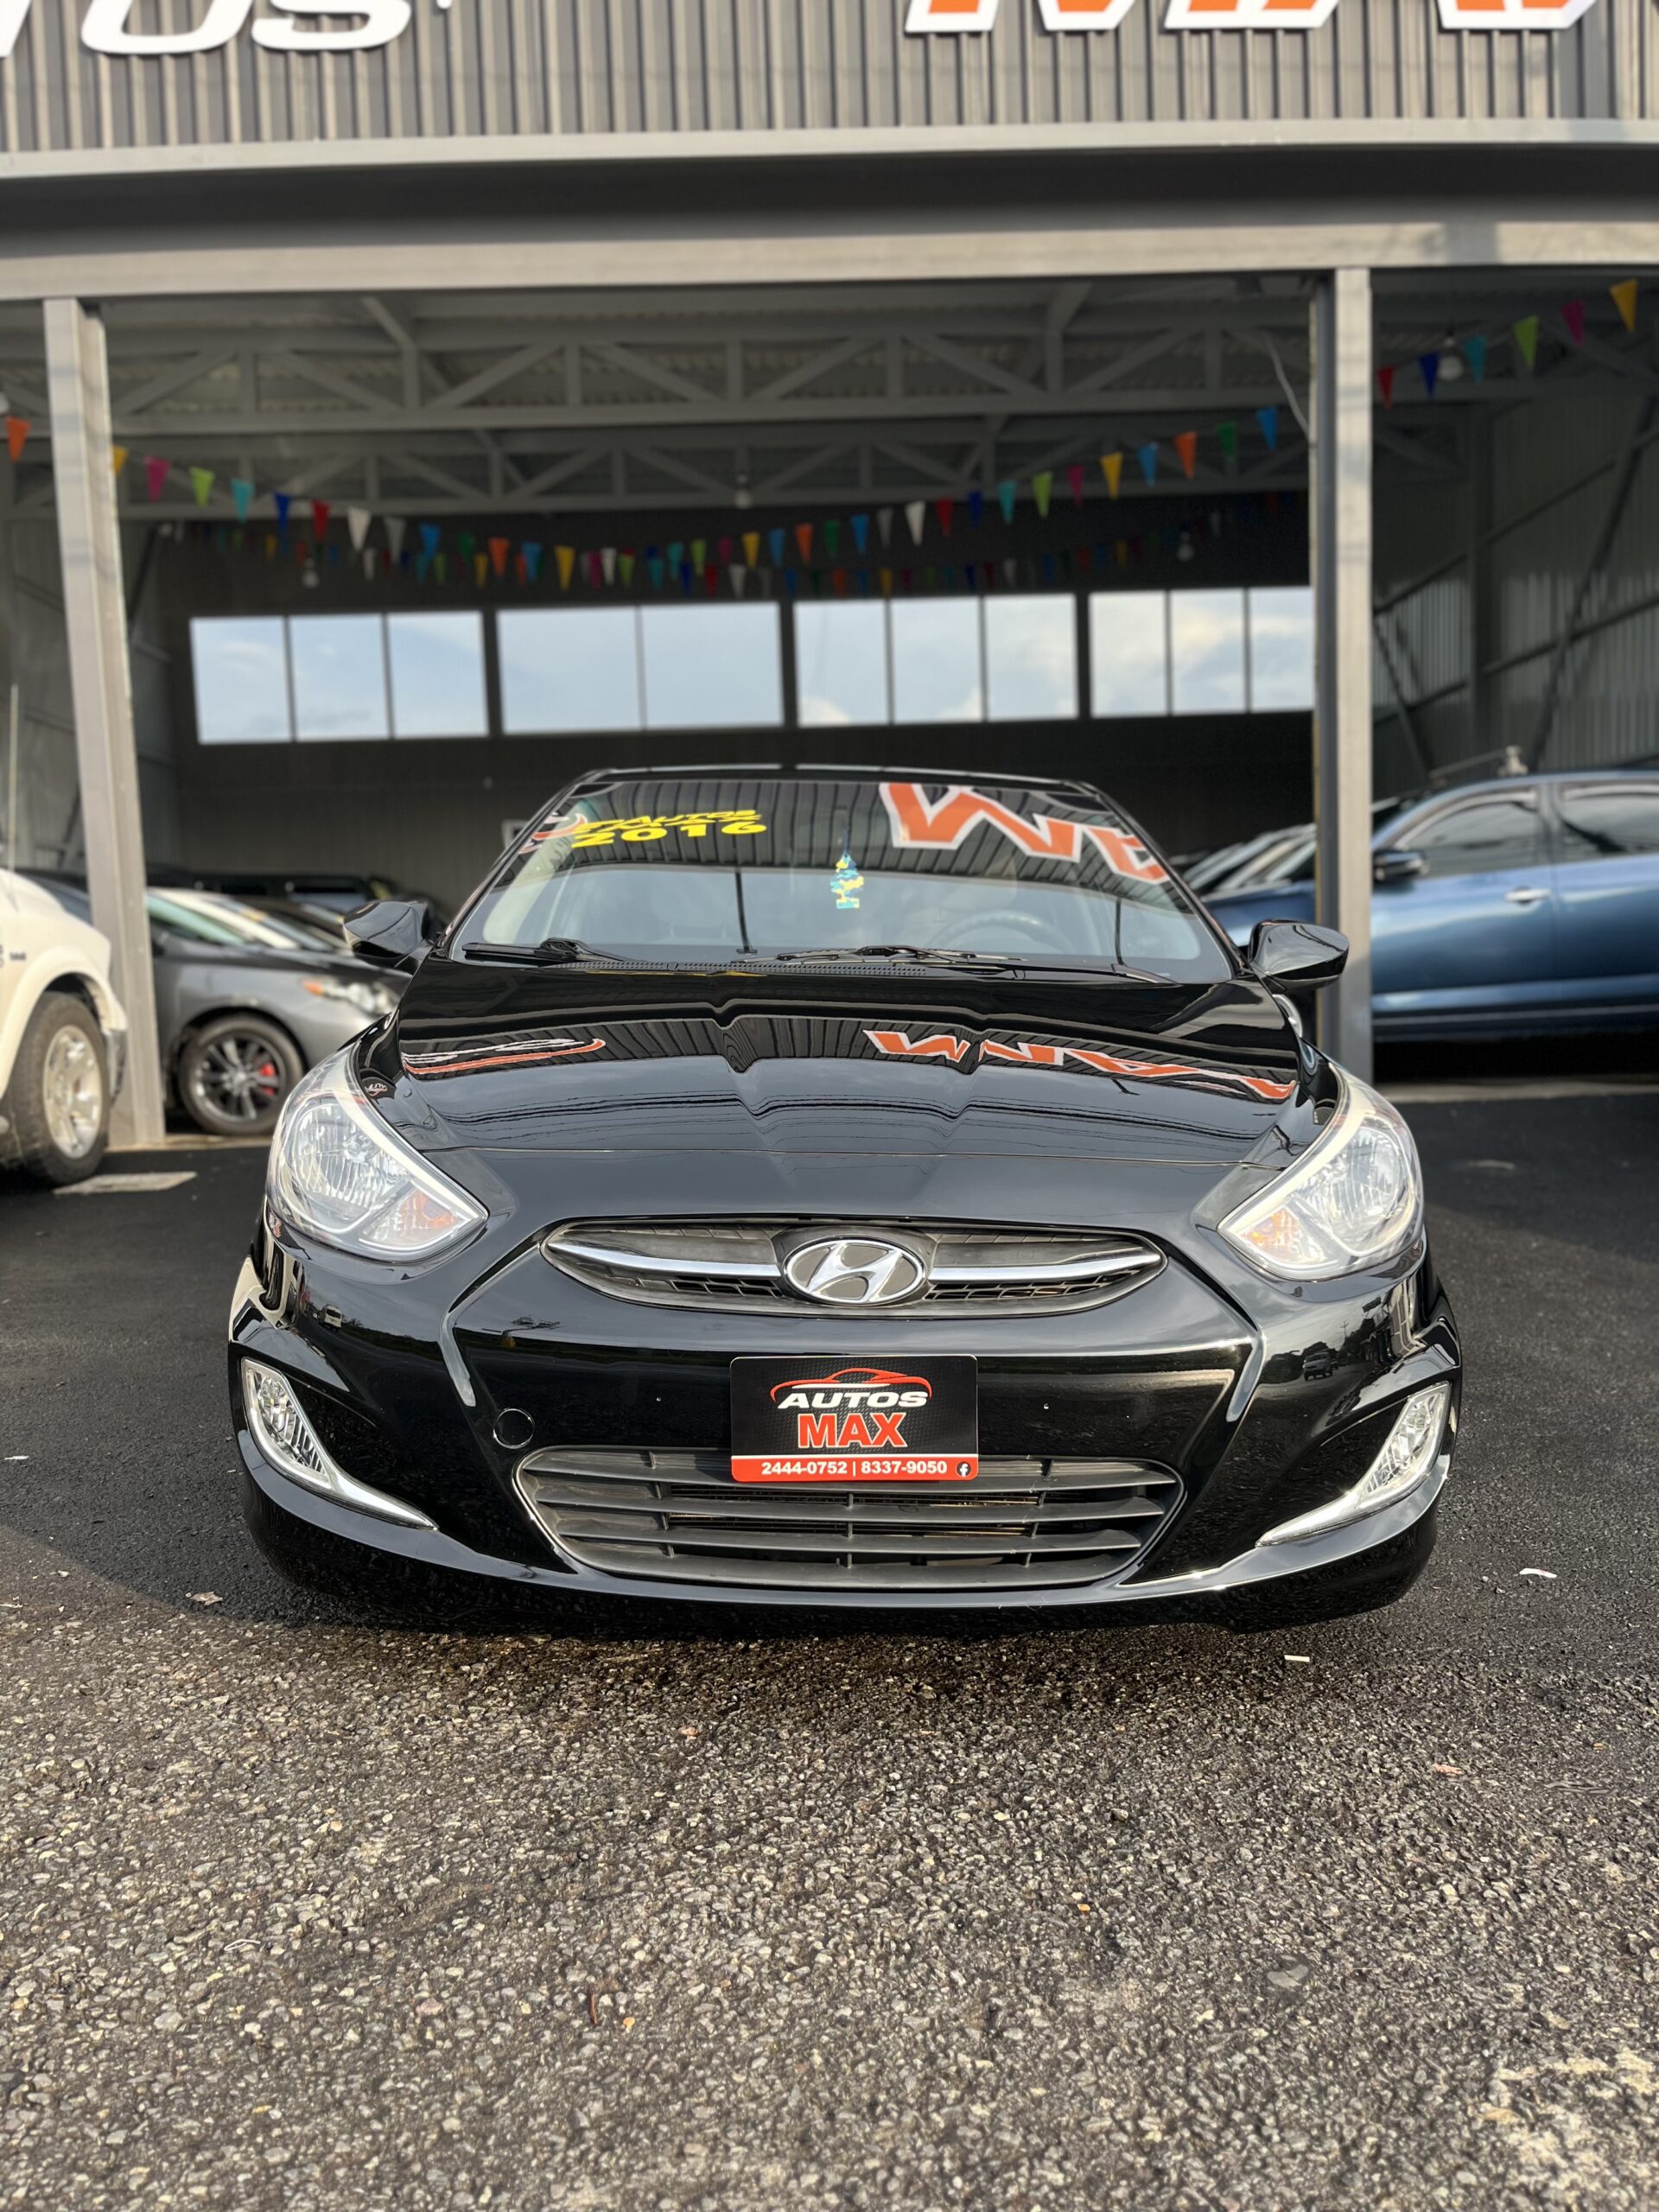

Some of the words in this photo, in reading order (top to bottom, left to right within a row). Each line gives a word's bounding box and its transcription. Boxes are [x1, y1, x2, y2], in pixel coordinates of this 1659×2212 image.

[571, 822, 767, 849] 2016
[778, 1391, 928, 1408] AUTOS
[798, 1412, 907, 1448] MAX
[761, 1461, 848, 1475] 2444-0752
[861, 1460, 947, 1474] 8337-9050
